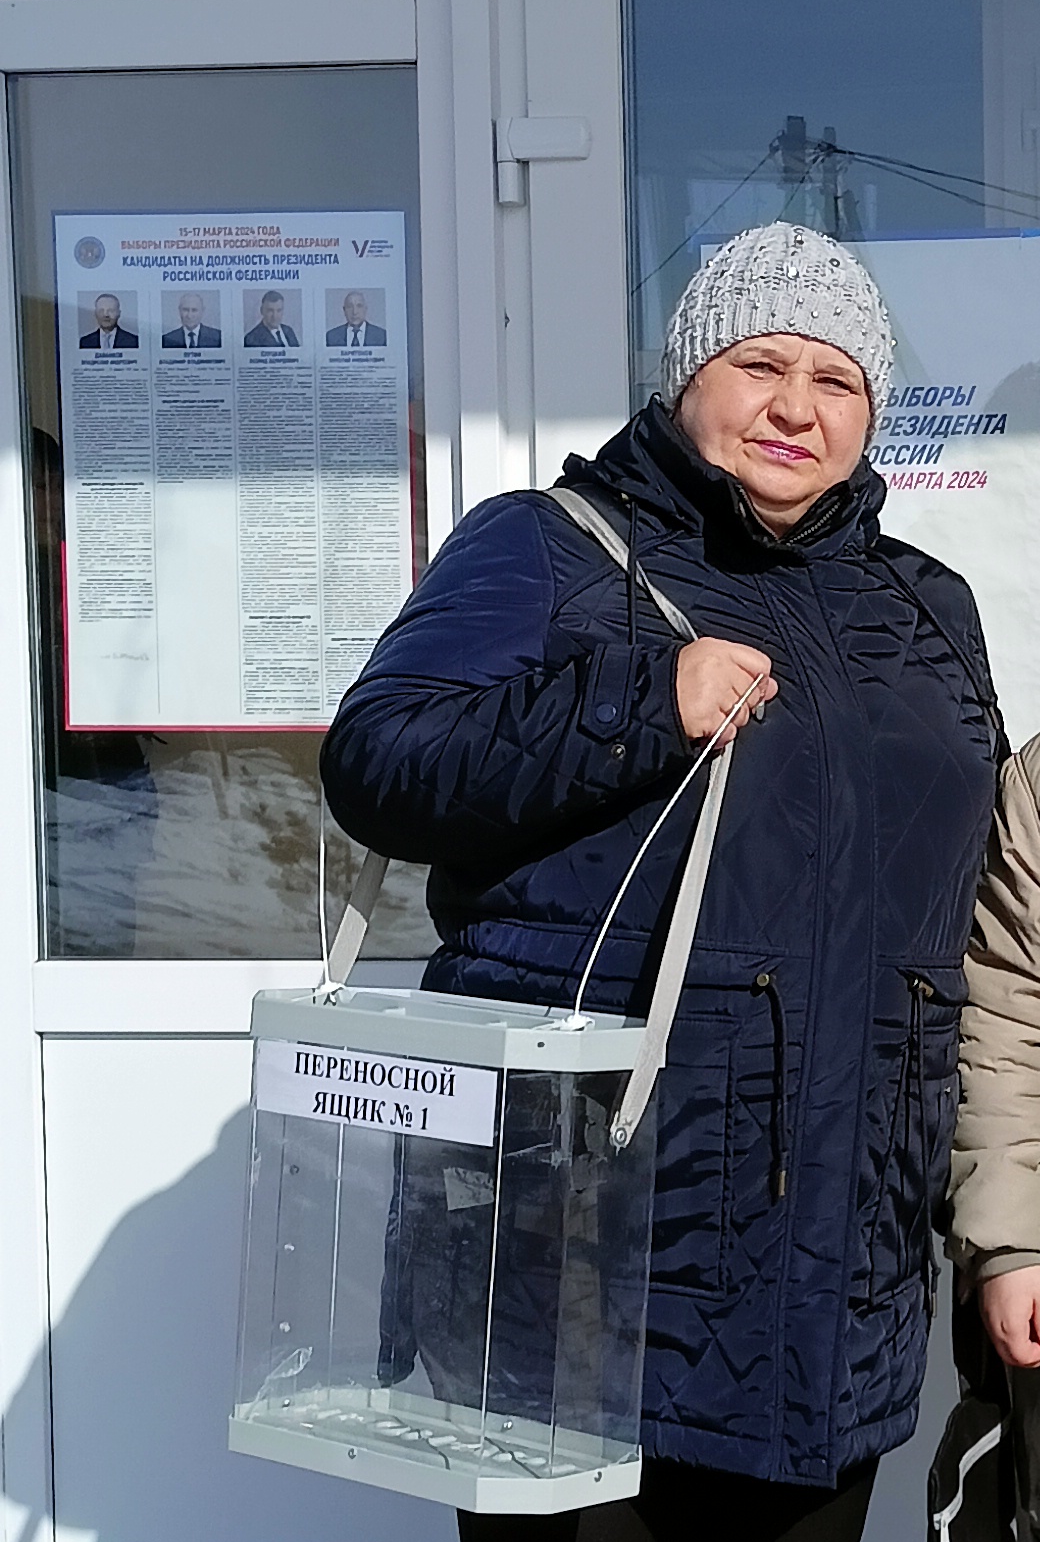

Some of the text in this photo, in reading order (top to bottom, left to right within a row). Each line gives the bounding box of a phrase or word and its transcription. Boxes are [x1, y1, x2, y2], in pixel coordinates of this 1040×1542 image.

[179, 225, 281, 236] 15-17 МАРТА 2024 ГОДА
[121, 236, 339, 250] ВЫБОРЫ ПРЕЗИДЕНТА РОССИЙСКОЙ ФЕДЕРАЦИИ
[122, 253, 339, 268] КАНДИДАТЫ НА ДОЛЖНОСТЬ ПРЕЗИДЕНТА
[162, 268, 300, 282] РОССИЙСКОЙ ФЕДЕРАЦИИ
[885, 386, 977, 408] ЫБОРЫ
[879, 413, 1008, 439] РЕЗИДЕНТА
[868, 444, 945, 465] ОССИИ
[888, 472, 944, 490] МАРТА
[947, 471, 988, 490] 2024
[294, 1051, 456, 1097] ПЕРЕНОСНОЙ
[312, 1091, 430, 1131] ЯЩИК № 1
